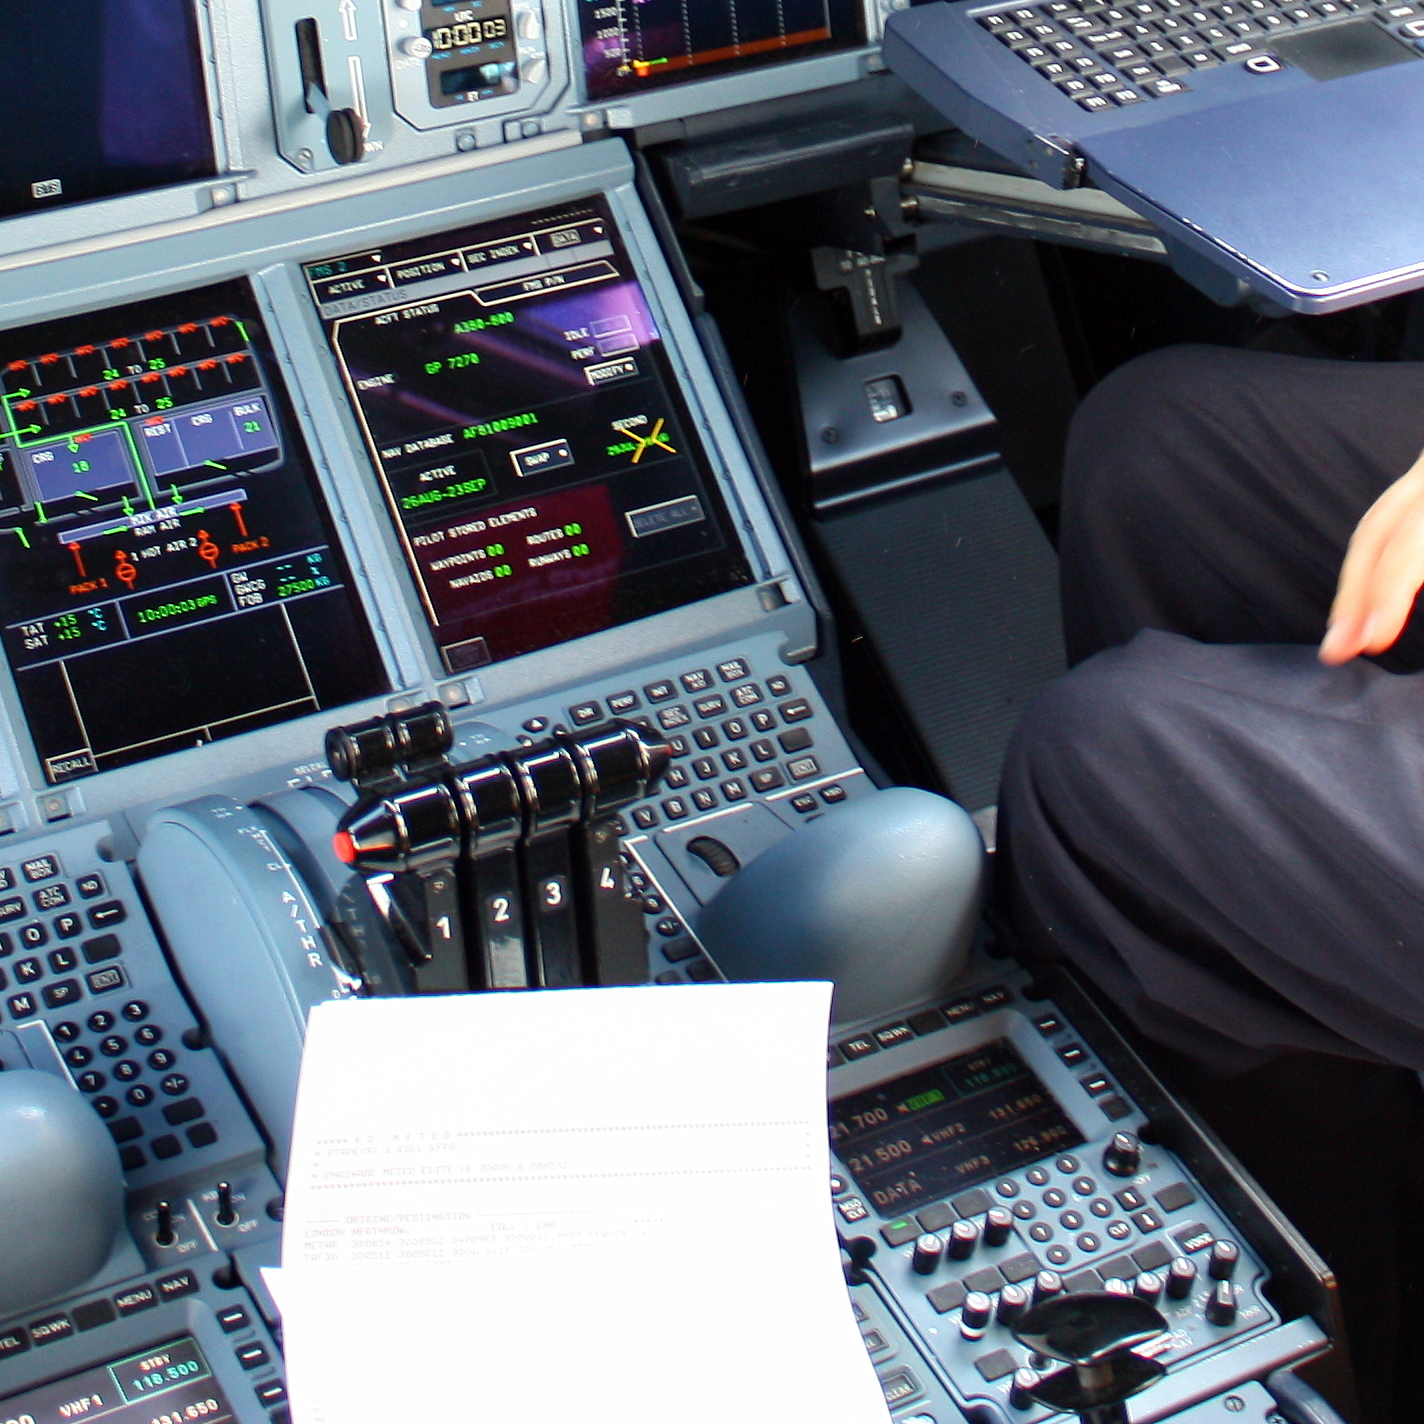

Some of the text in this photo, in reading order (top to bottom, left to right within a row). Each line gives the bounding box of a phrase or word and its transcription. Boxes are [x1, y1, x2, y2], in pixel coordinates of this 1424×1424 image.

[403, 303, 440, 319] STATUS
[102, 368, 120, 380] 24
[148, 357, 166, 371] 25
[109, 408, 126, 420] 24
[155, 396, 173, 410] 25
[381, 433, 454, 460] NAV DATABASE
[418, 465, 456, 482] ACTIVE
[413, 529, 445, 547] PILOT
[488, 507, 538, 530] ELEMENTS
[429, 550, 486, 571] WAYPOINTS
[21, 622, 45, 637] TAT
[24, 634, 48, 649] SAT
[546, 880, 562, 904] 3
[493, 898, 510, 921] 2
[436, 917, 451, 938] 1
[162, 1277, 190, 1292] NAV
[116, 1290, 152, 1308] MENU
[31, 1319, 70, 1338] SQWK
[60, 1394, 103, 1417] VHF1
